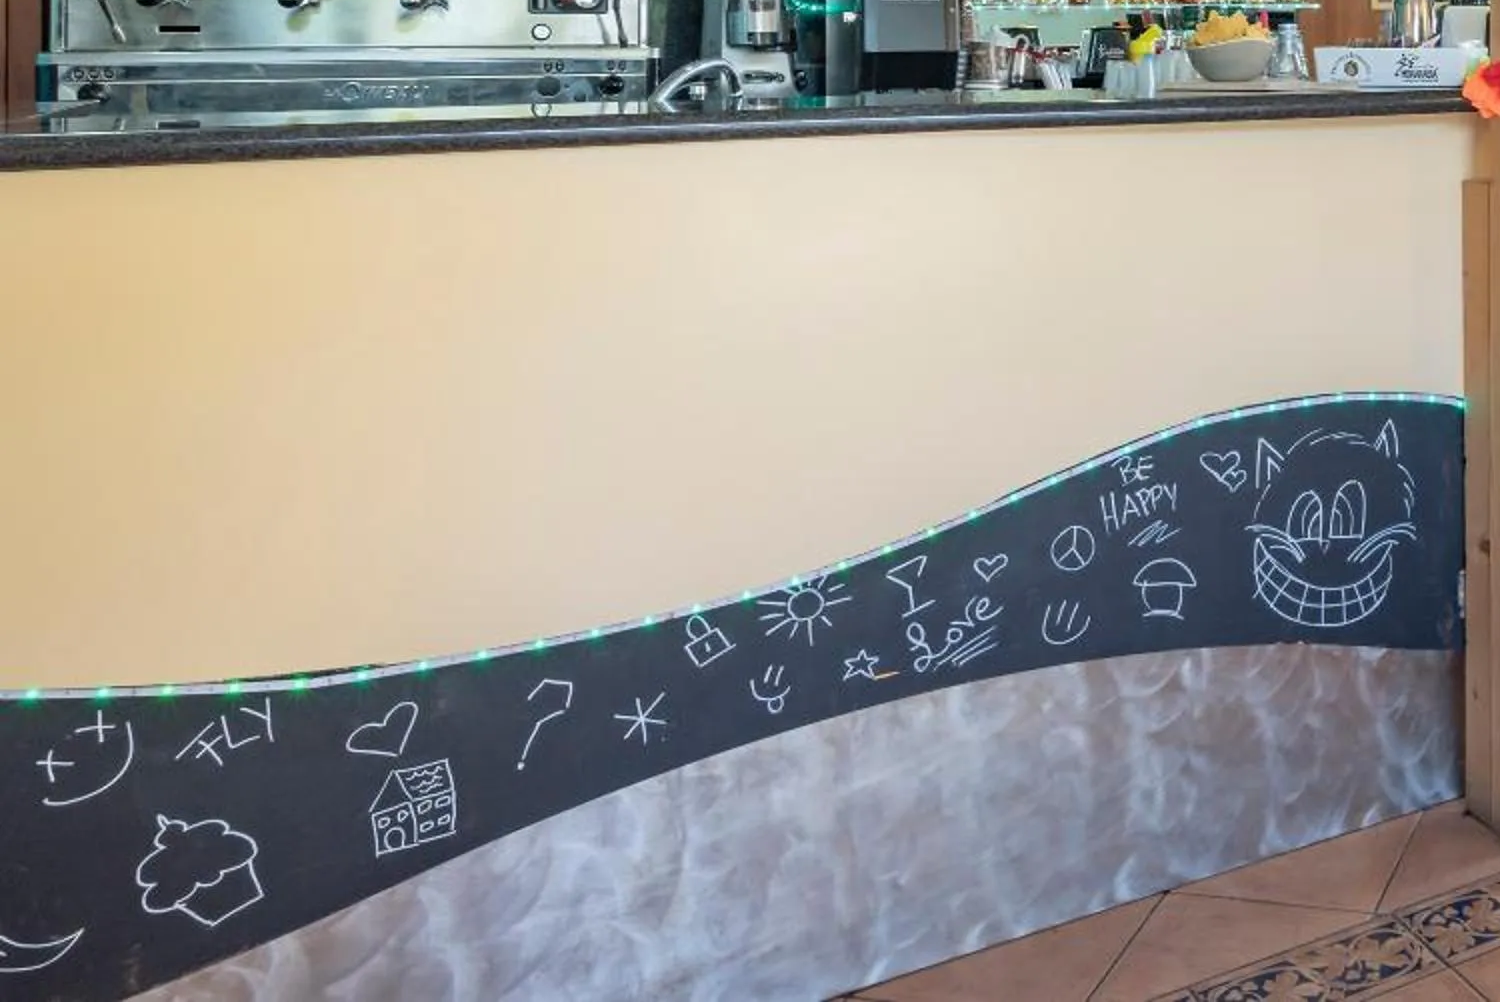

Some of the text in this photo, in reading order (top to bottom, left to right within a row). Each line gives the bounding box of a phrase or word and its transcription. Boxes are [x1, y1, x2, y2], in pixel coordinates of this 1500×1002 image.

[1111, 455, 1155, 486] BE
[1099, 482, 1178, 534] HAPPY
[906, 595, 1004, 674] Love
[174, 696, 275, 766] FLY
